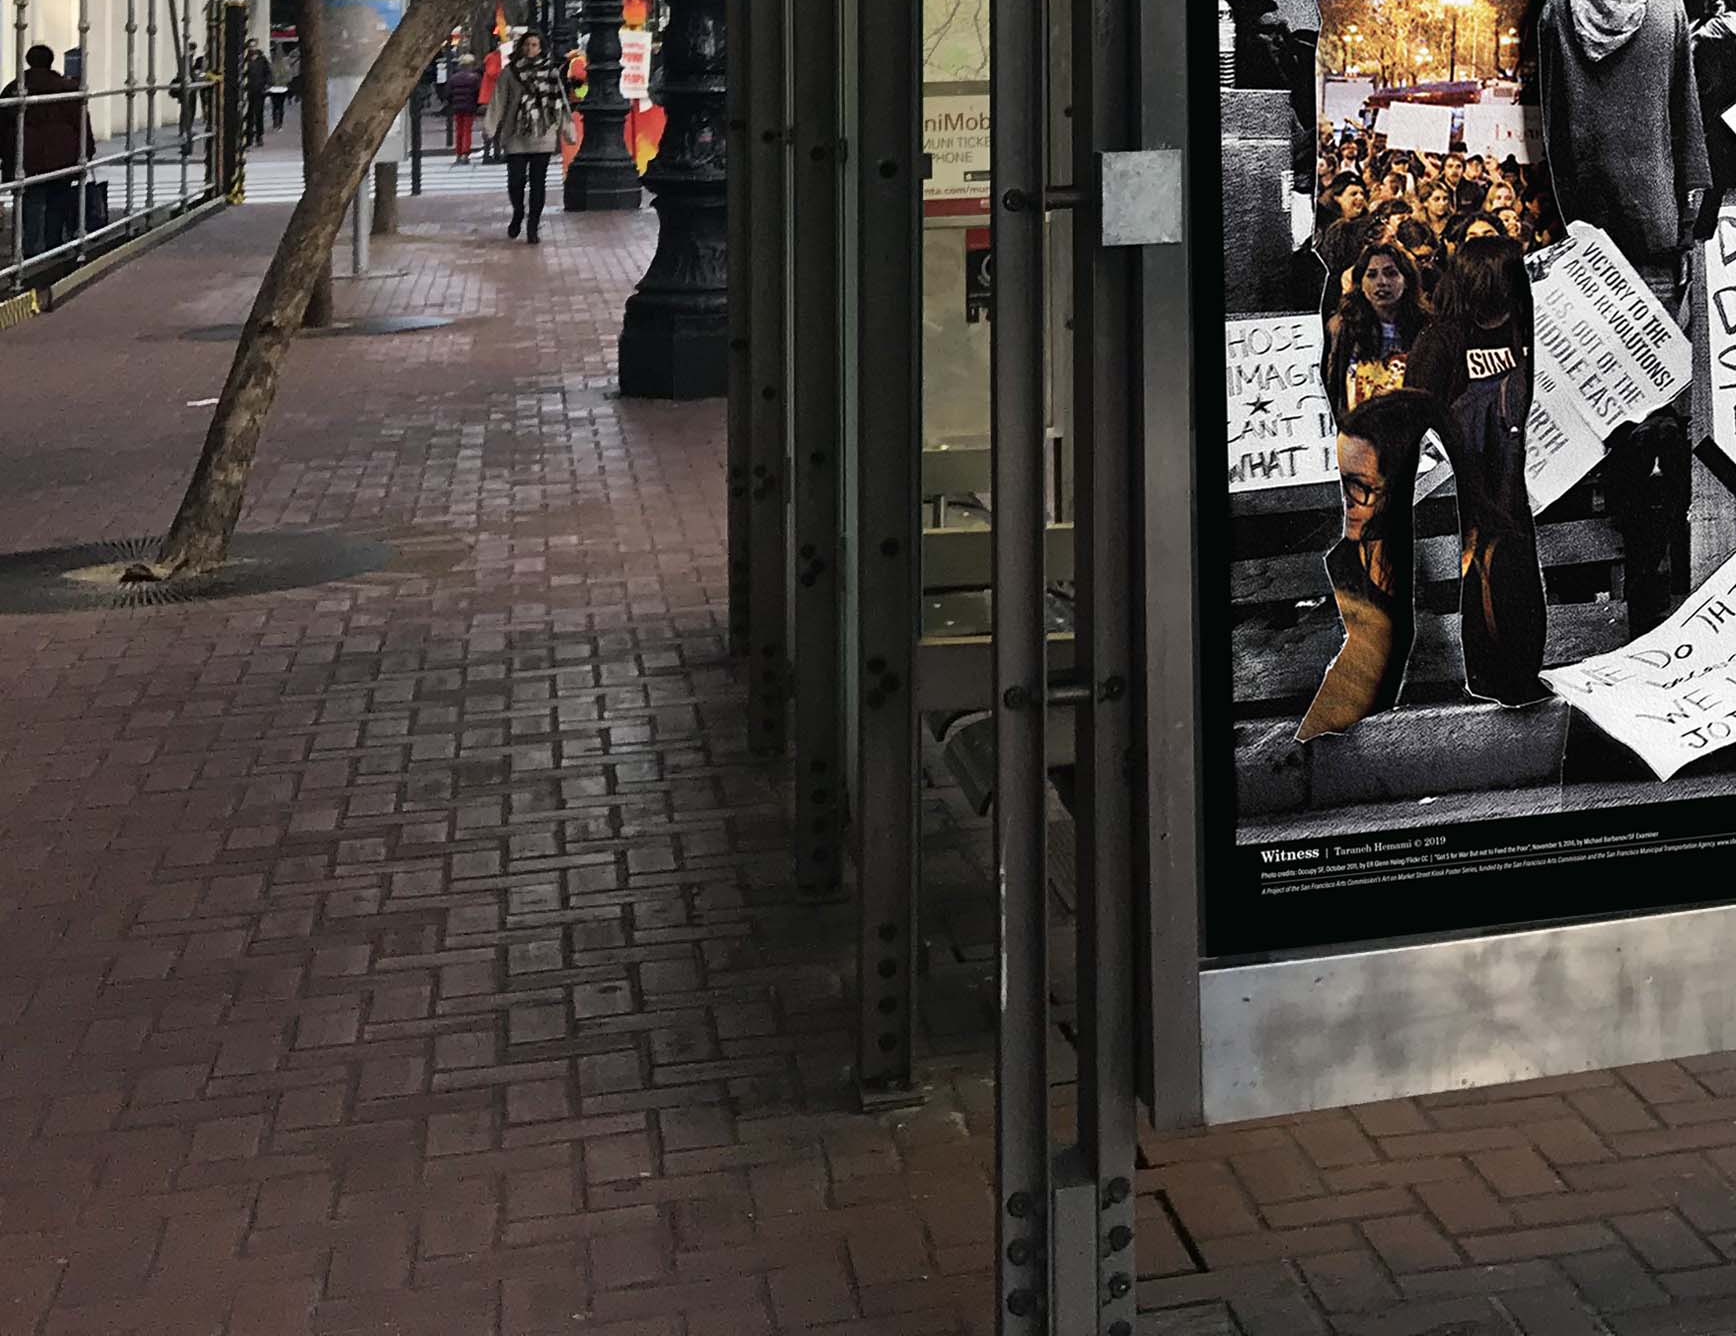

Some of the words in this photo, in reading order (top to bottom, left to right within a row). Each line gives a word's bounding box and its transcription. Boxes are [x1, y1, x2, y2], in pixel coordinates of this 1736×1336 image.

[924, 112, 990, 132] niMob
[957, 136, 990, 148] TICKE
[1582, 241, 1636, 301] VICTORY
[1627, 295, 1650, 321] TO
[1642, 313, 1672, 349] THE
[1563, 258, 1599, 298] ARAB
[1592, 293, 1676, 393] REVOLUTIONS!
[1544, 287, 1575, 324] U.S.
[1571, 319, 1603, 355] OUT
[1596, 350, 1623, 377] OF
[1612, 371, 1646, 411] THE
[1534, 369, 1557, 393] AND
[1578, 372, 1629, 427] EAST
[1562, 665, 1636, 695] WE
[1635, 690, 1722, 724] WE
[1260, 844, 1320, 863] Witness
[1334, 843, 1371, 856] Taraneh
[1424, 835, 1446, 846] 2019
